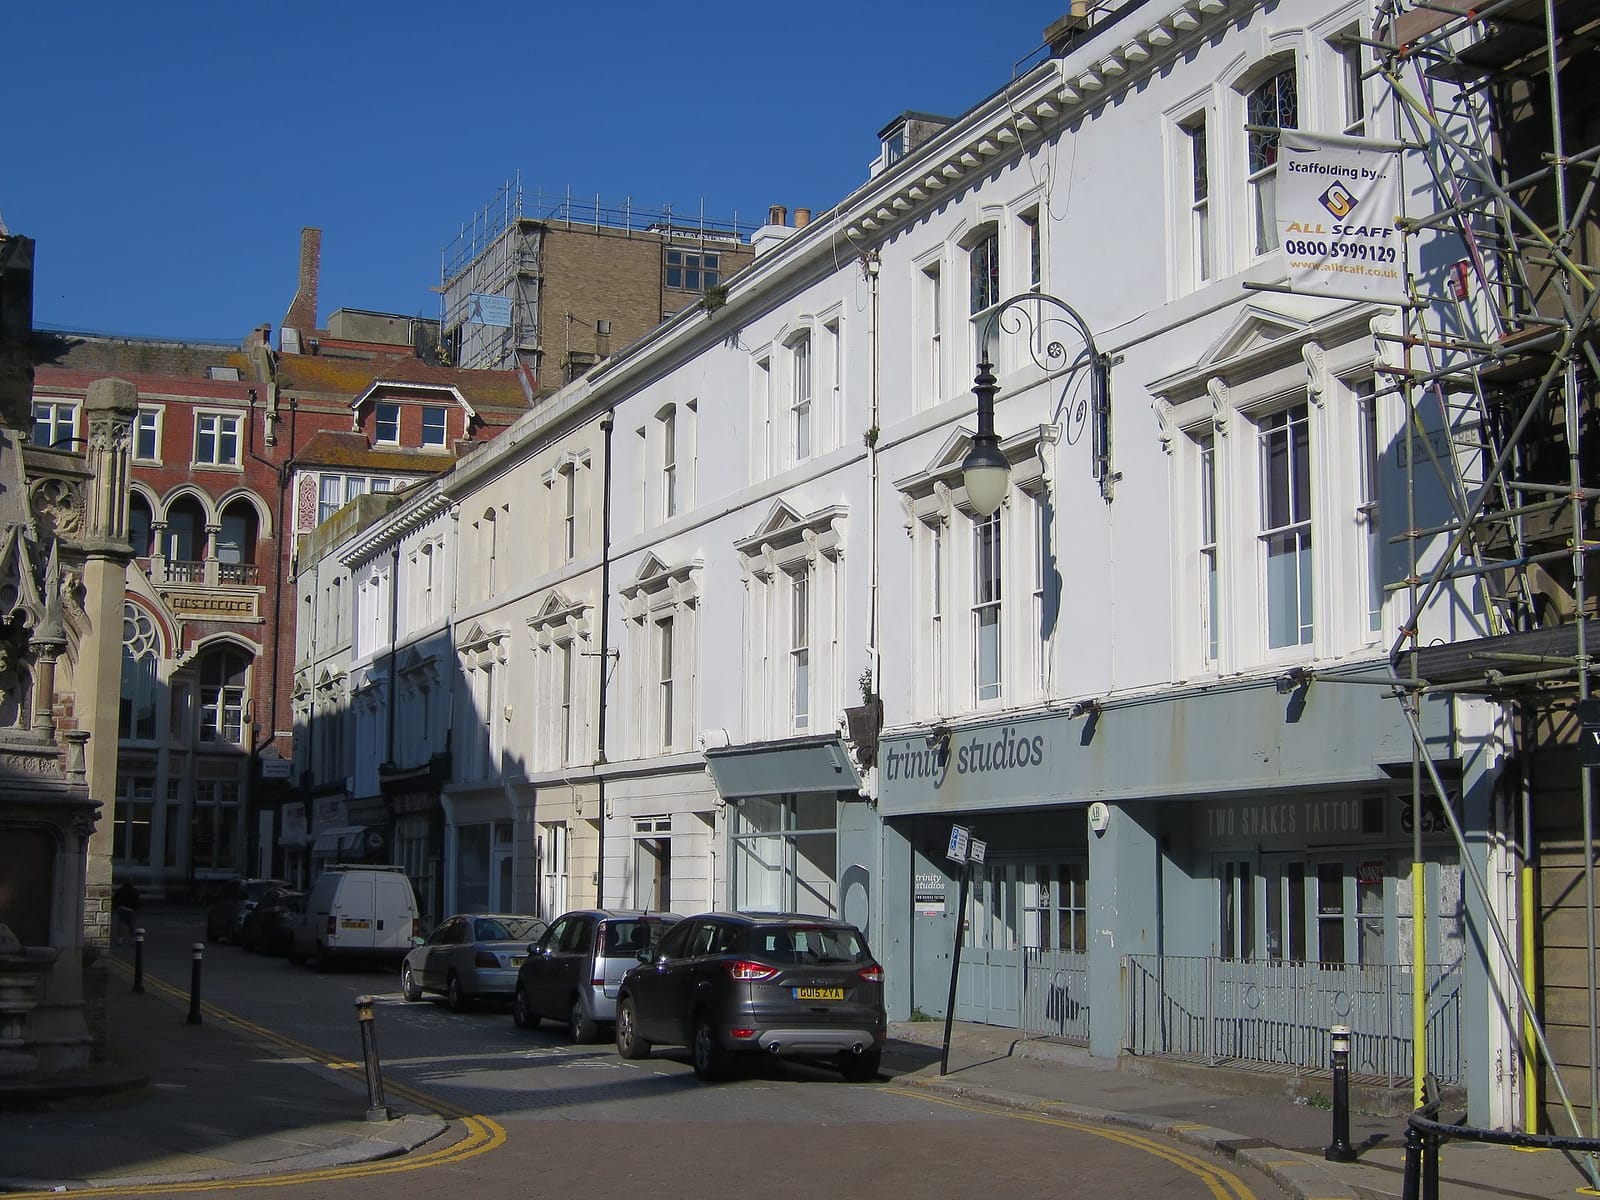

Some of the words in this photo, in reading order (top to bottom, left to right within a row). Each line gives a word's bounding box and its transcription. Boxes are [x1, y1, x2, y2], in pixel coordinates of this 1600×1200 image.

[1288, 161, 1358, 180] Scaffolding
[1285, 221, 1326, 234] ALL
[1331, 225, 1393, 239] SCAFF
[1285, 240, 1327, 256] 0800
[1330, 242, 1396, 263] 5999129
[1289, 260, 1398, 279] www.allscaff.co.uk
[887, 743, 952, 789] trinity
[957, 728, 1044, 774] studios
[1208, 808, 1234, 837] TWO
[1242, 804, 1297, 836] SNAKES
[1304, 800, 1360, 833] TATTOO
[914, 881, 945, 890] studios
[915, 873, 941, 883] trinity
